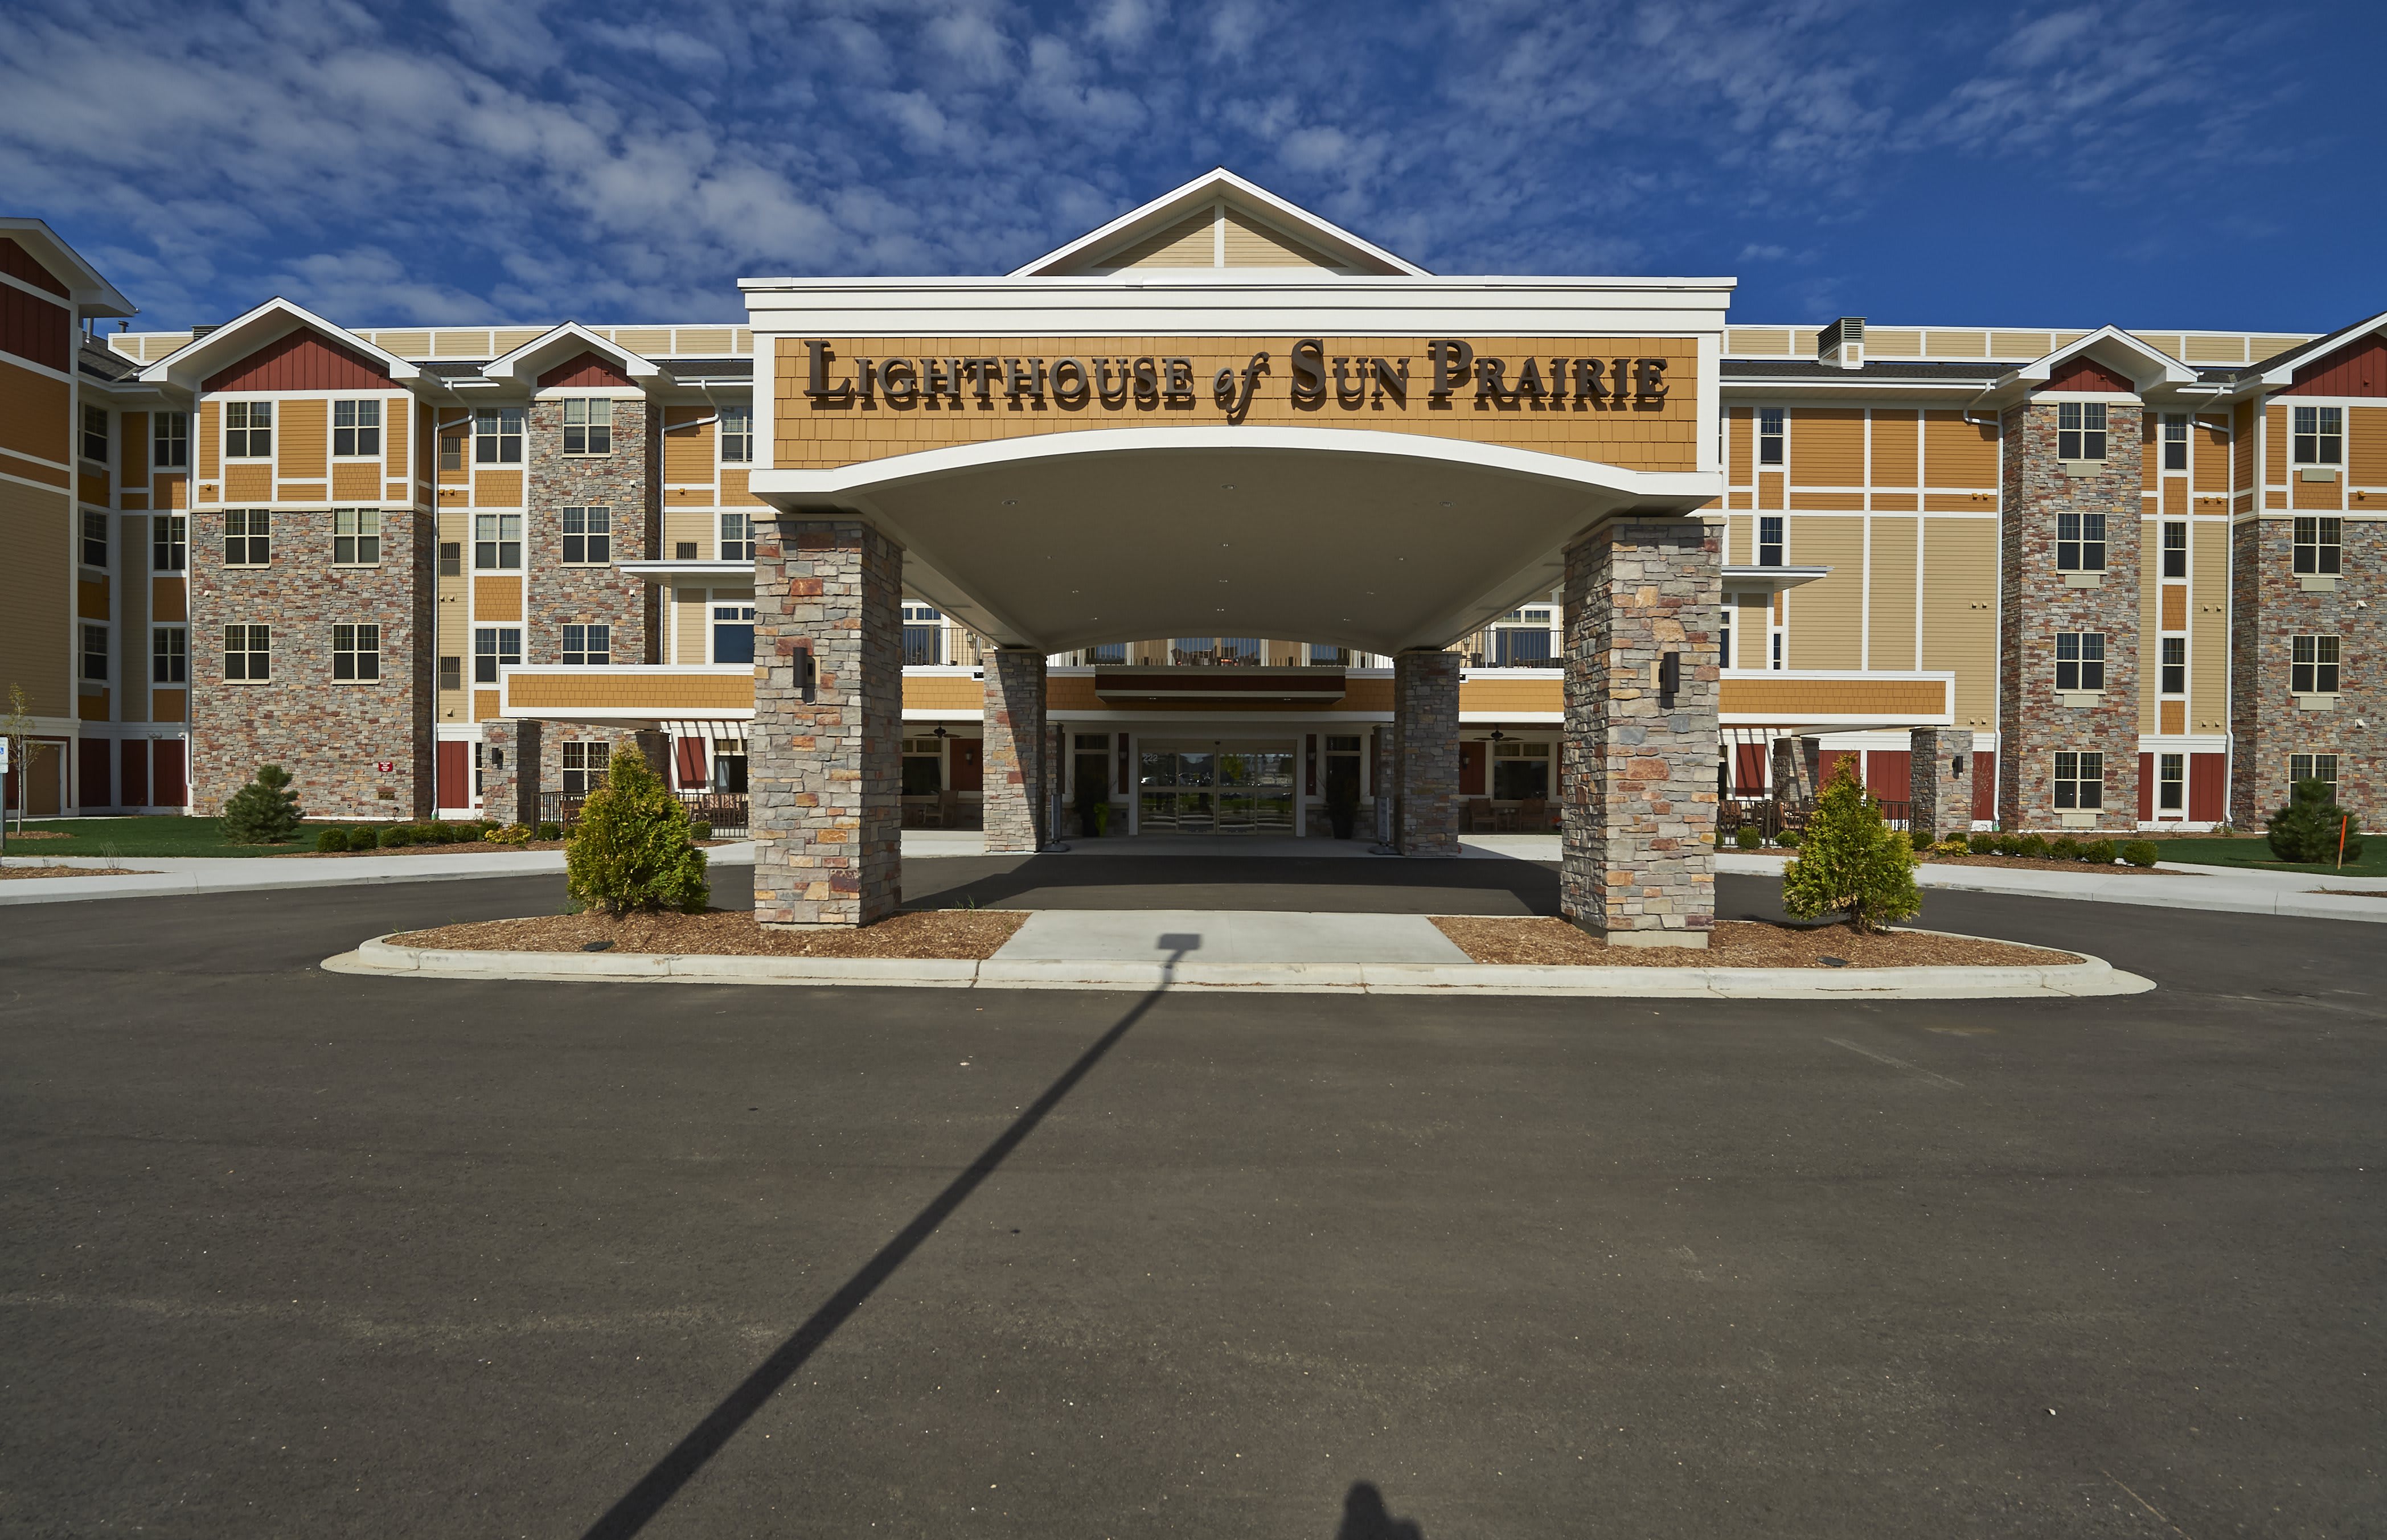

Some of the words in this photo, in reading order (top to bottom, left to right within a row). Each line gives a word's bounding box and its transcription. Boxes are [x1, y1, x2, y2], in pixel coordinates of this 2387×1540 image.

[803, 340, 1194, 399] LIGHTHOUSE
[1213, 352, 1270, 414] of
[1290, 338, 1410, 397] SUN
[1428, 339, 1670, 398] PRAIRIE
